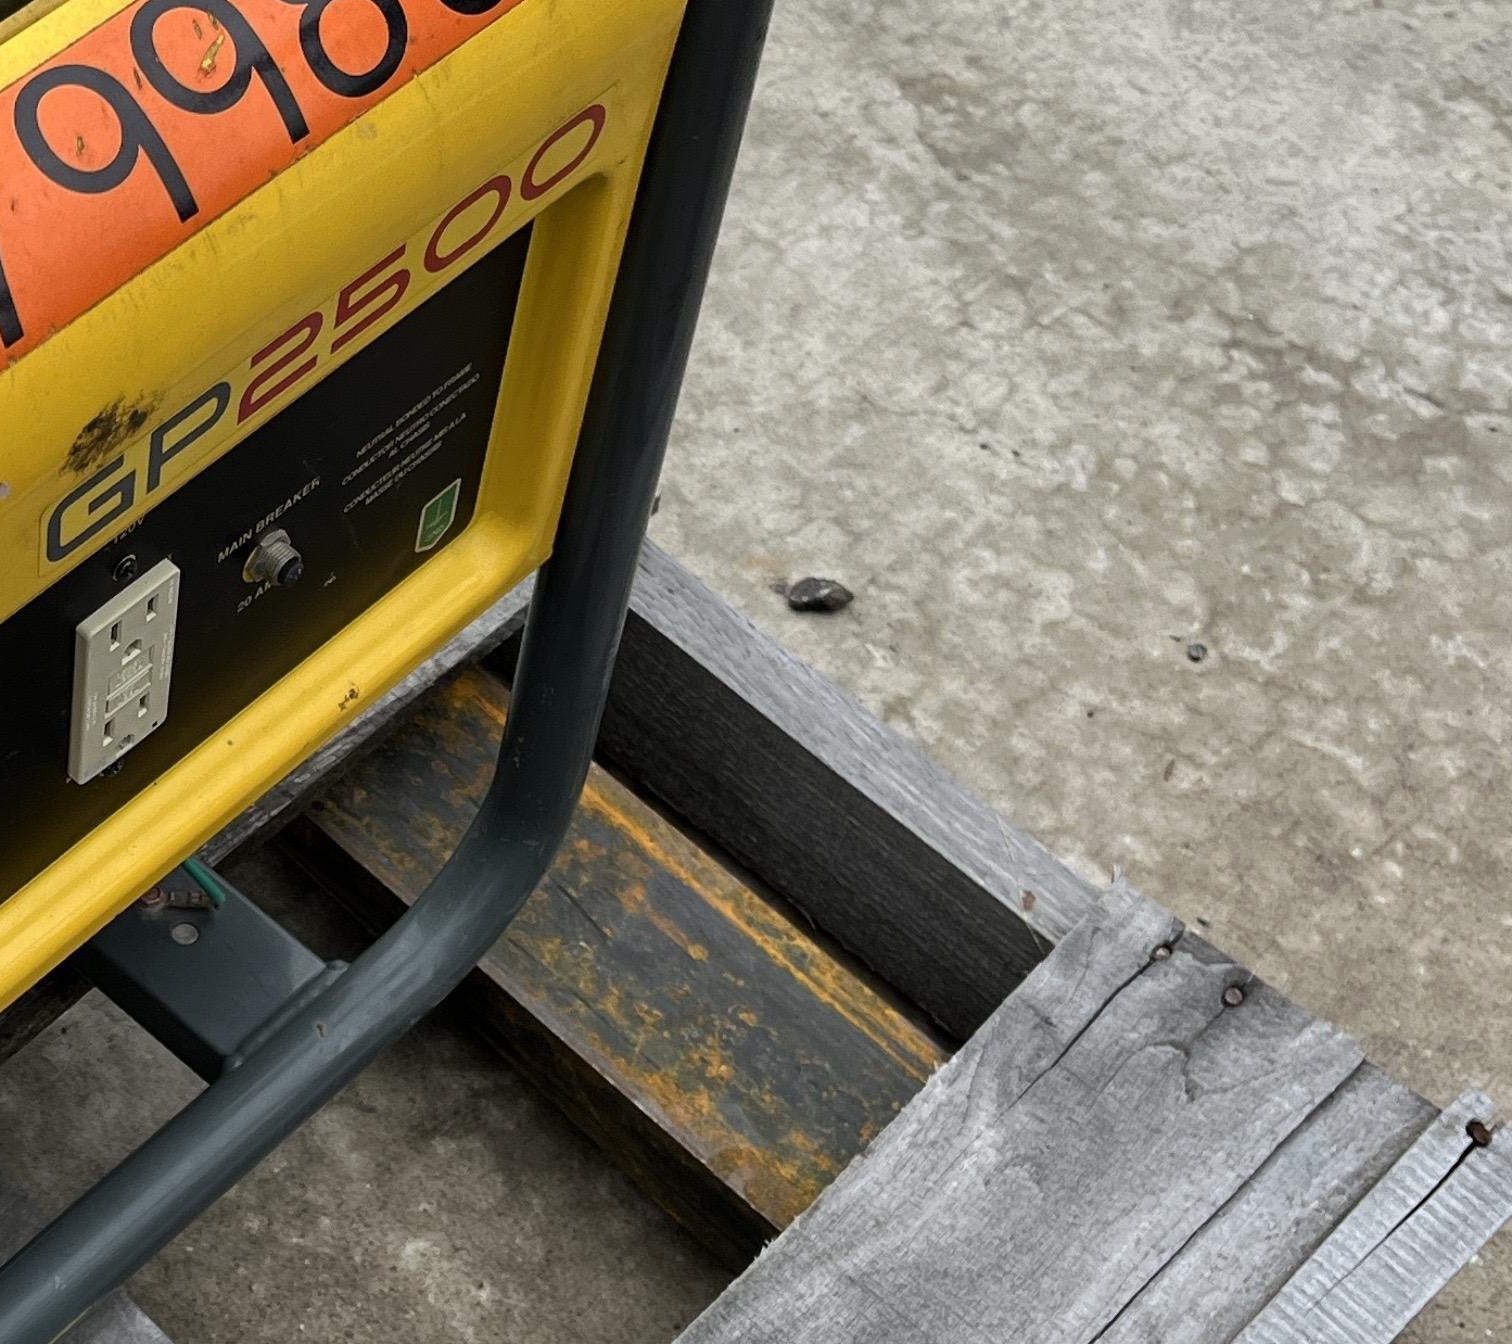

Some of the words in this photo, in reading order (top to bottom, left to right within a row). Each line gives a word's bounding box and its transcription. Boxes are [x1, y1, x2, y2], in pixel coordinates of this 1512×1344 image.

[45, 103, 606, 565] GP2500
[217, 529, 253, 563] MAIN
[255, 476, 320, 534] BREAKER
[237, 595, 252, 613] 20
